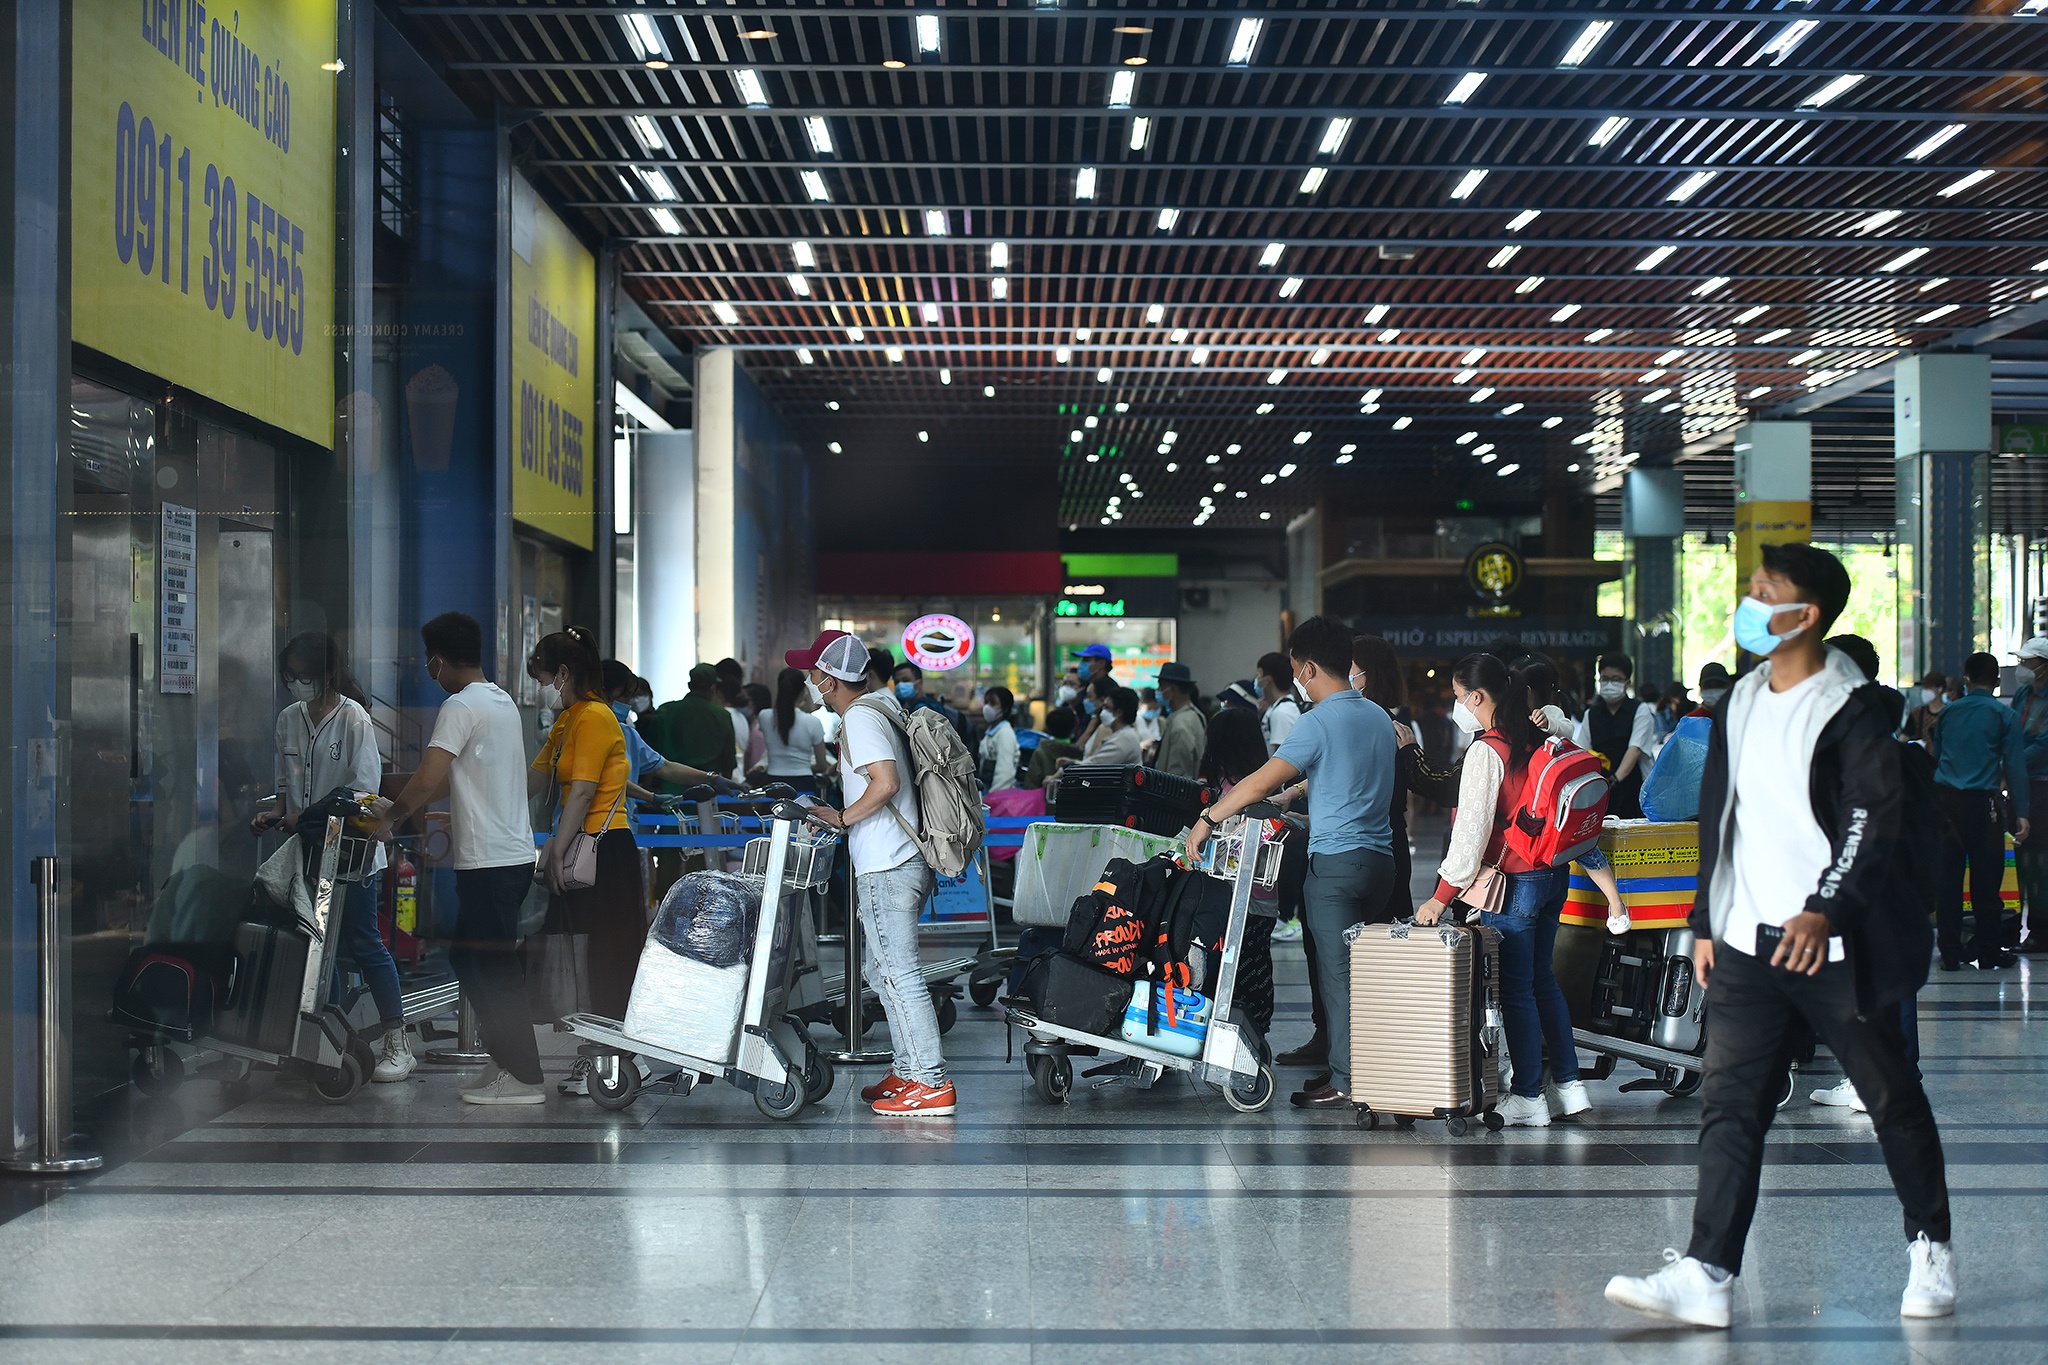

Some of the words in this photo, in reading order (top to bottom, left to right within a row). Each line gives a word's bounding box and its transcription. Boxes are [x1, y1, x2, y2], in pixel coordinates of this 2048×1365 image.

[211, 10, 260, 131] QUẢNG
[264, 59, 290, 154] CÁO
[115, 101, 191, 295] 0911
[203, 163, 237, 320] 39
[245, 191, 304, 356] 5555
[521, 379, 544, 477] 0911
